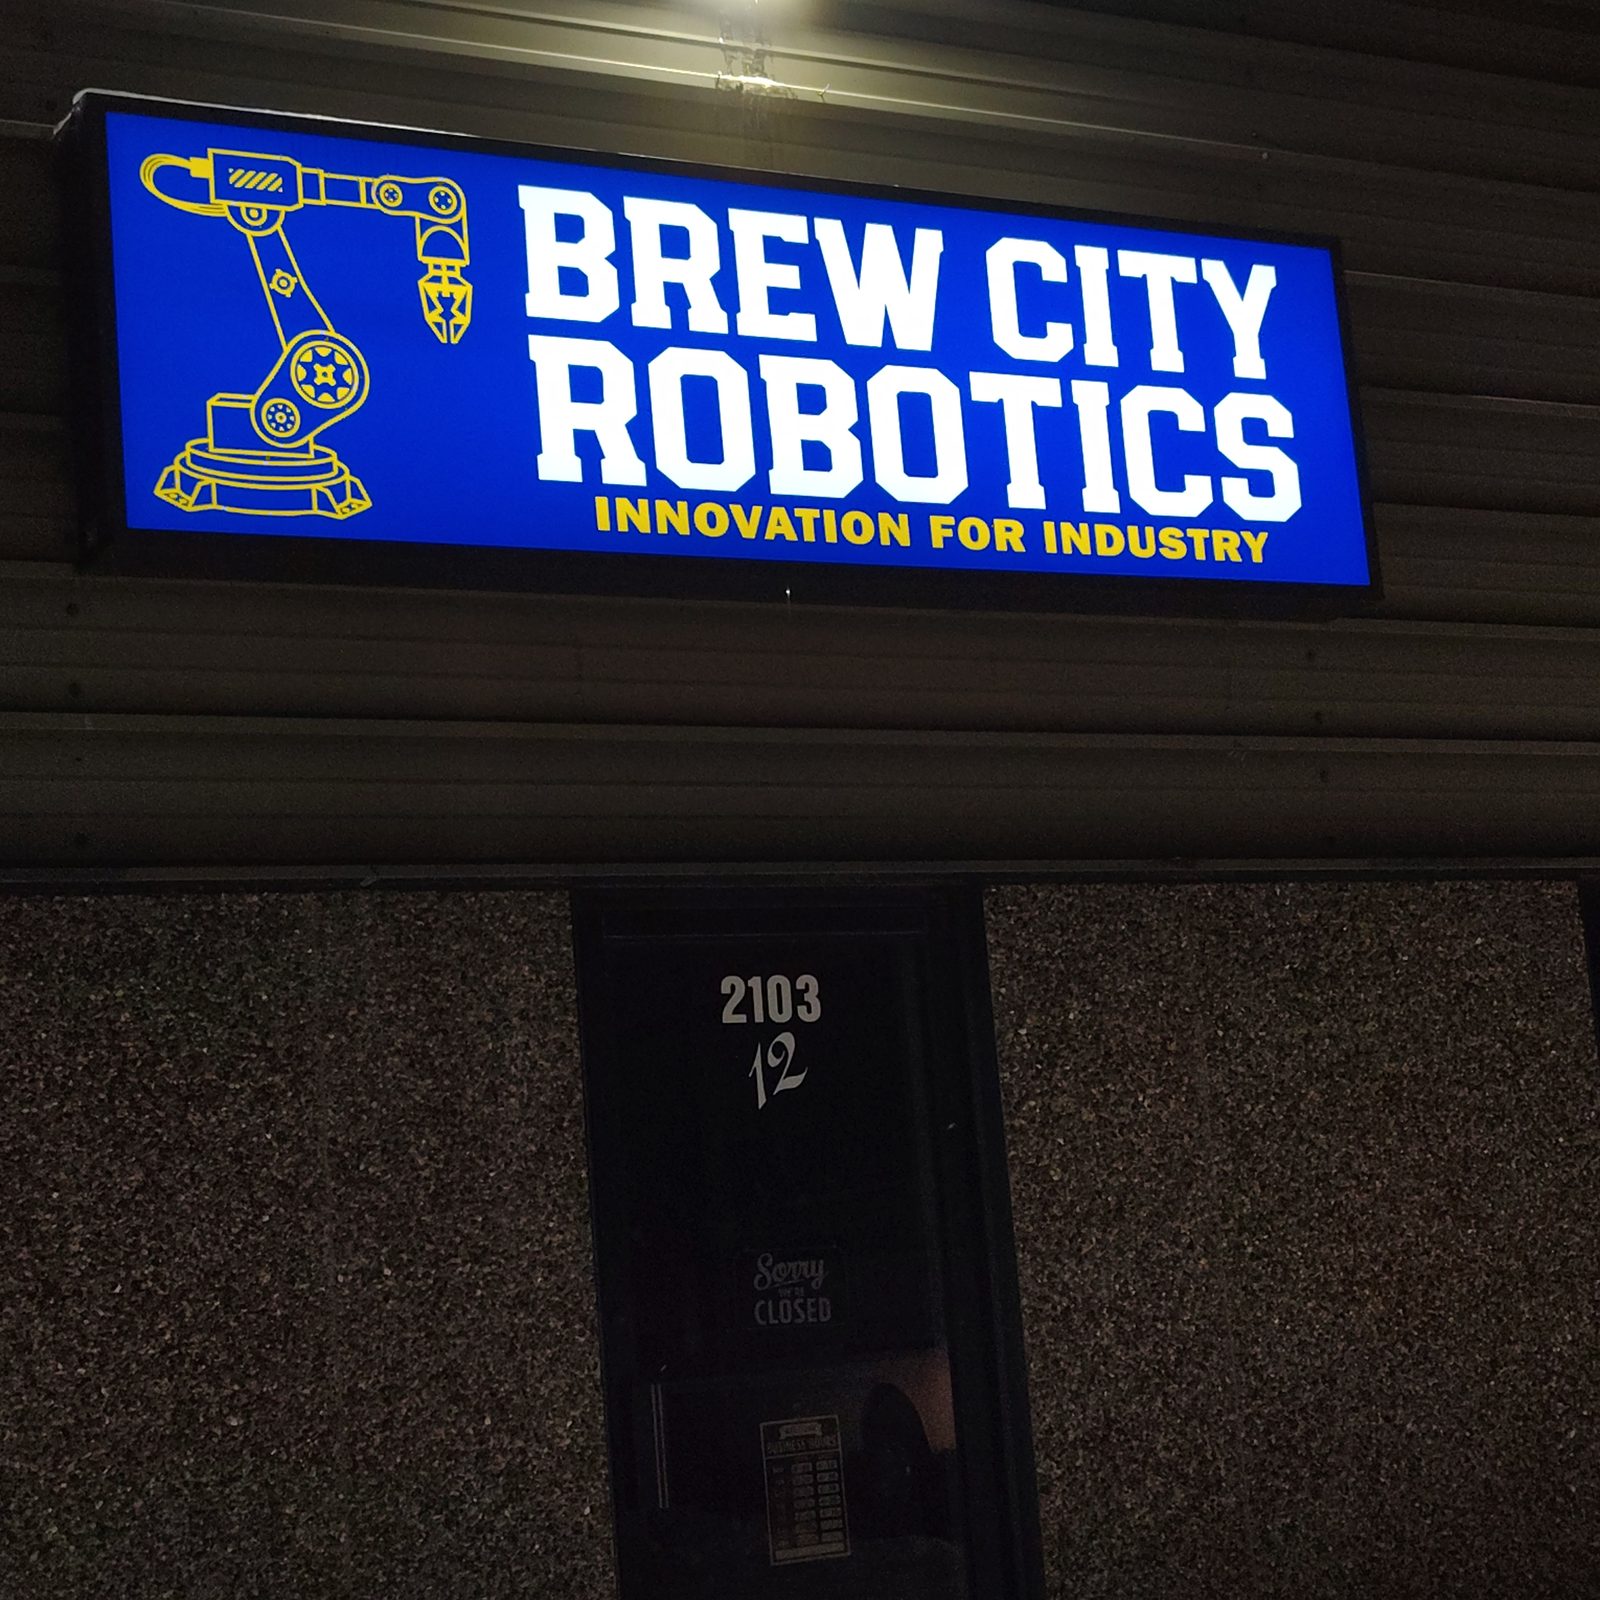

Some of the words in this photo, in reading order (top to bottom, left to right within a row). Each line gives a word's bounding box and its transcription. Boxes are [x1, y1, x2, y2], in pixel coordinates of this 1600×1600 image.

[518, 185, 943, 351] BREW
[986, 238, 1277, 380] CITY
[528, 335, 1302, 523] ROBOTICS
[595, 496, 911, 548] INNOVATION
[929, 515, 1026, 554] FOR
[1043, 520, 1269, 564] INDUSTRY
[720, 973, 822, 1024] 2103
[749, 1031, 808, 1110] 12
[753, 1253, 827, 1291] Sorry
[754, 1297, 832, 1326] CLOSED
